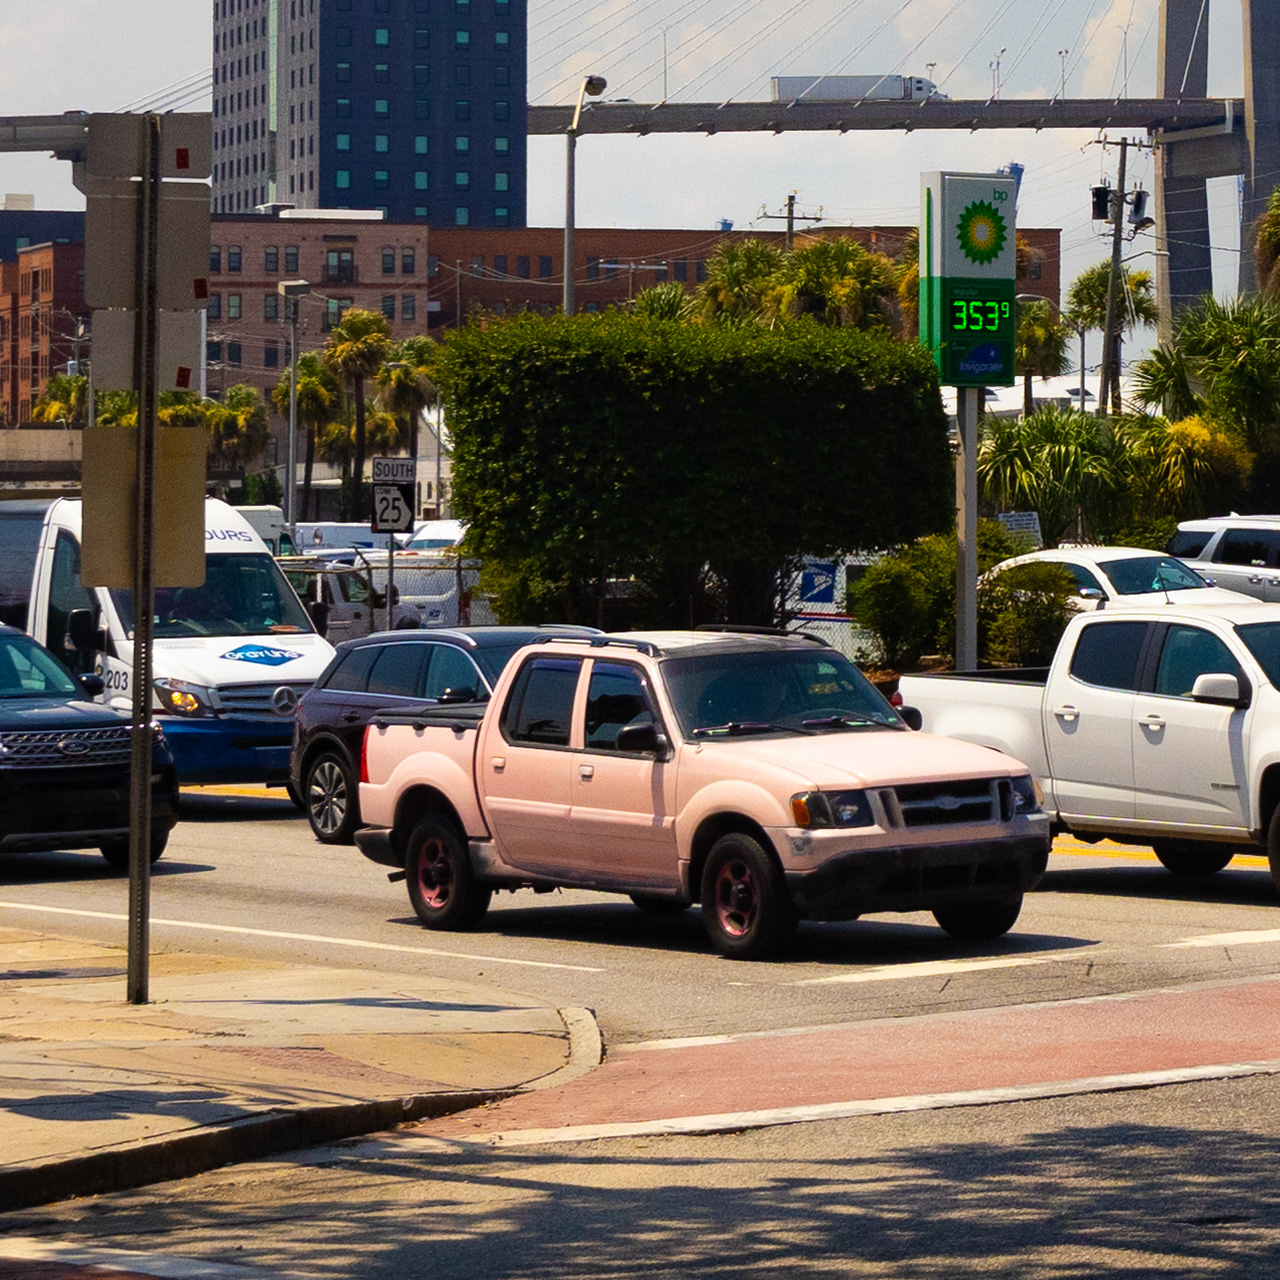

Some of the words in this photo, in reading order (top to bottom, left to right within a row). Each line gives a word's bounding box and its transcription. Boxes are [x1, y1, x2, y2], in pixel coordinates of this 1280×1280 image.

[993, 187, 1008, 204] bp
[375, 462, 414, 477] SOUTH
[379, 496, 402, 523] 25
[205, 529, 253, 542] OURS
[106, 670, 128, 691] 203
